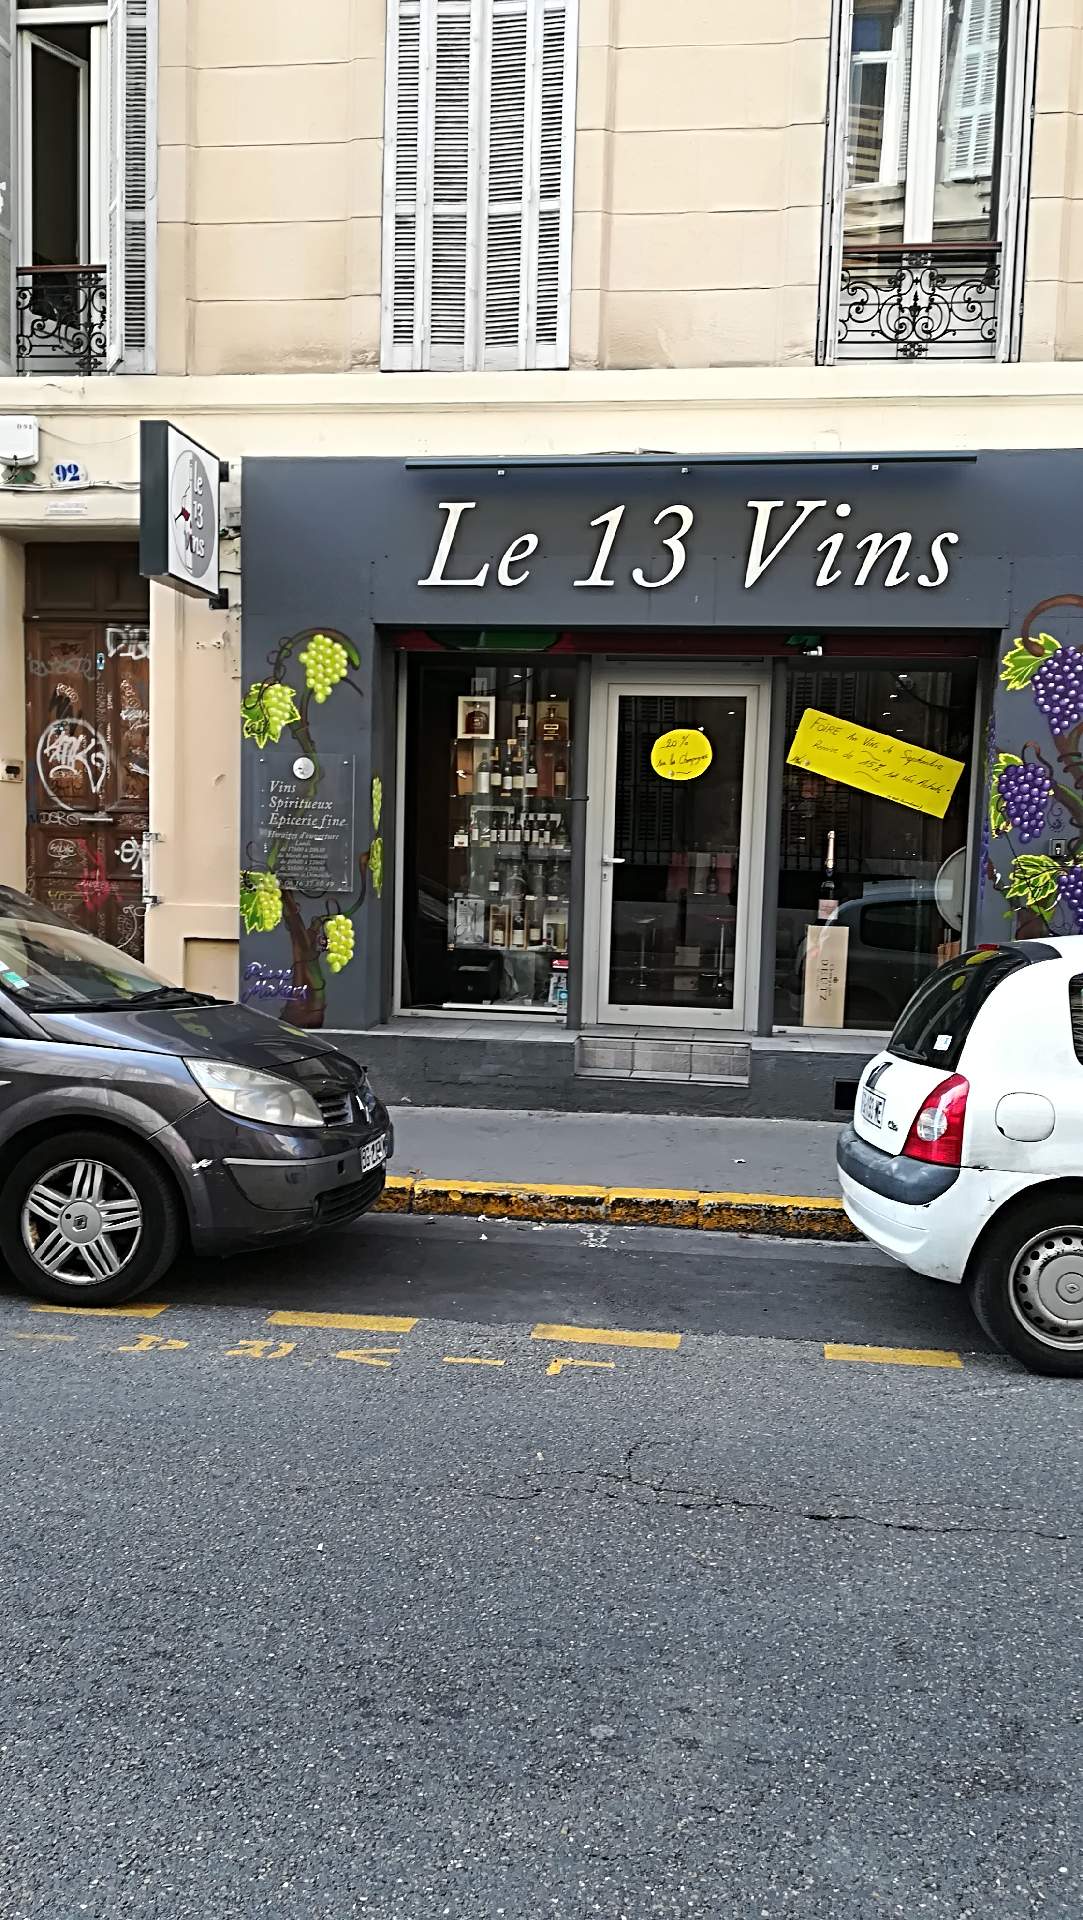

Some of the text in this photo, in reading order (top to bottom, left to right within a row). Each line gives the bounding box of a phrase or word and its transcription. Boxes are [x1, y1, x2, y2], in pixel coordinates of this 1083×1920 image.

[55, 463, 80, 482] 92
[193, 501, 204, 529] 13
[416, 500, 960, 589] Le 13 Vins
[269, 780, 297, 793] Vins
[268, 796, 333, 812] Spiritueux
[268, 813, 347, 830] Epicerie fine
